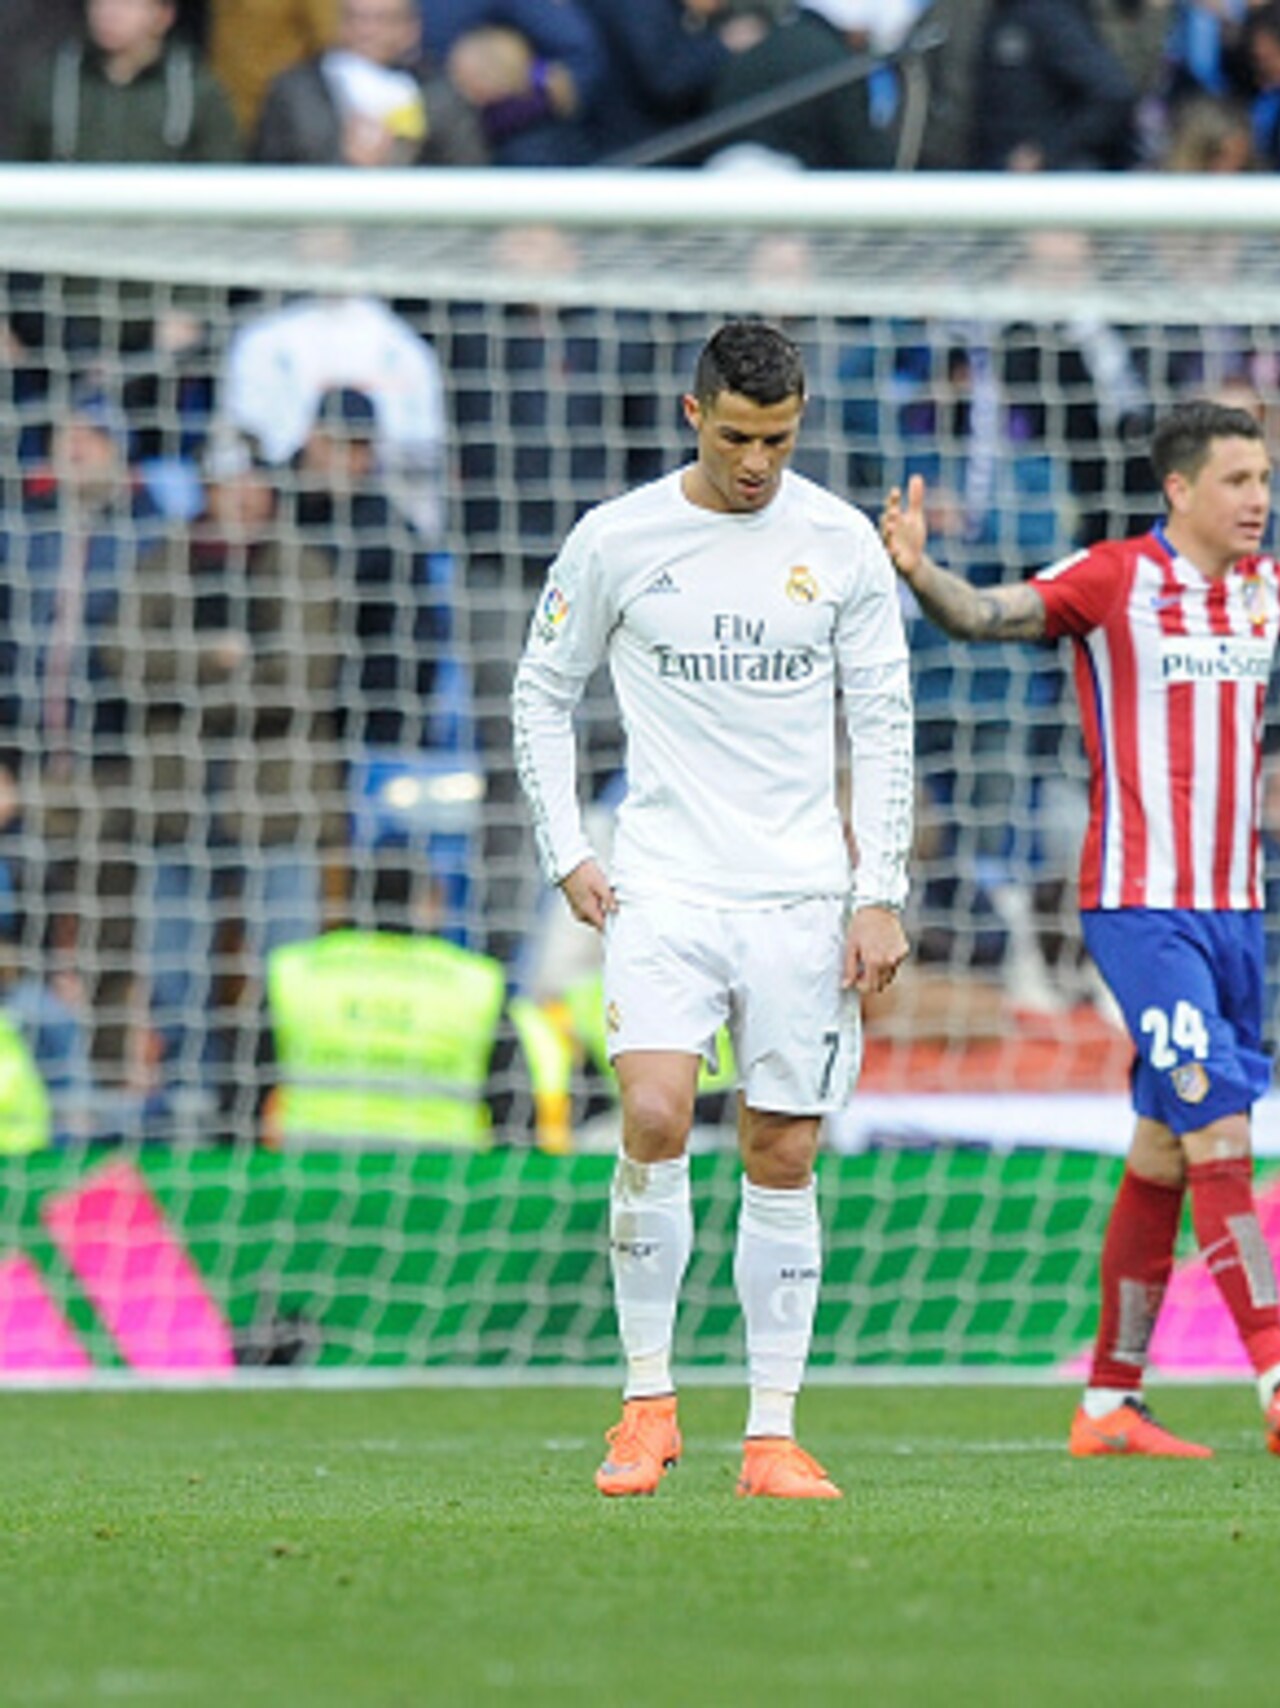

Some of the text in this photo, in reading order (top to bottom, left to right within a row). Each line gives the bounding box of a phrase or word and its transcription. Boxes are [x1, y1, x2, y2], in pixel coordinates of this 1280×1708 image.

[713, 613, 765, 646] Fly
[653, 645, 814, 683] Emirates
[1140, 999, 1209, 1070] 24
[821, 1031, 840, 1099] 7
